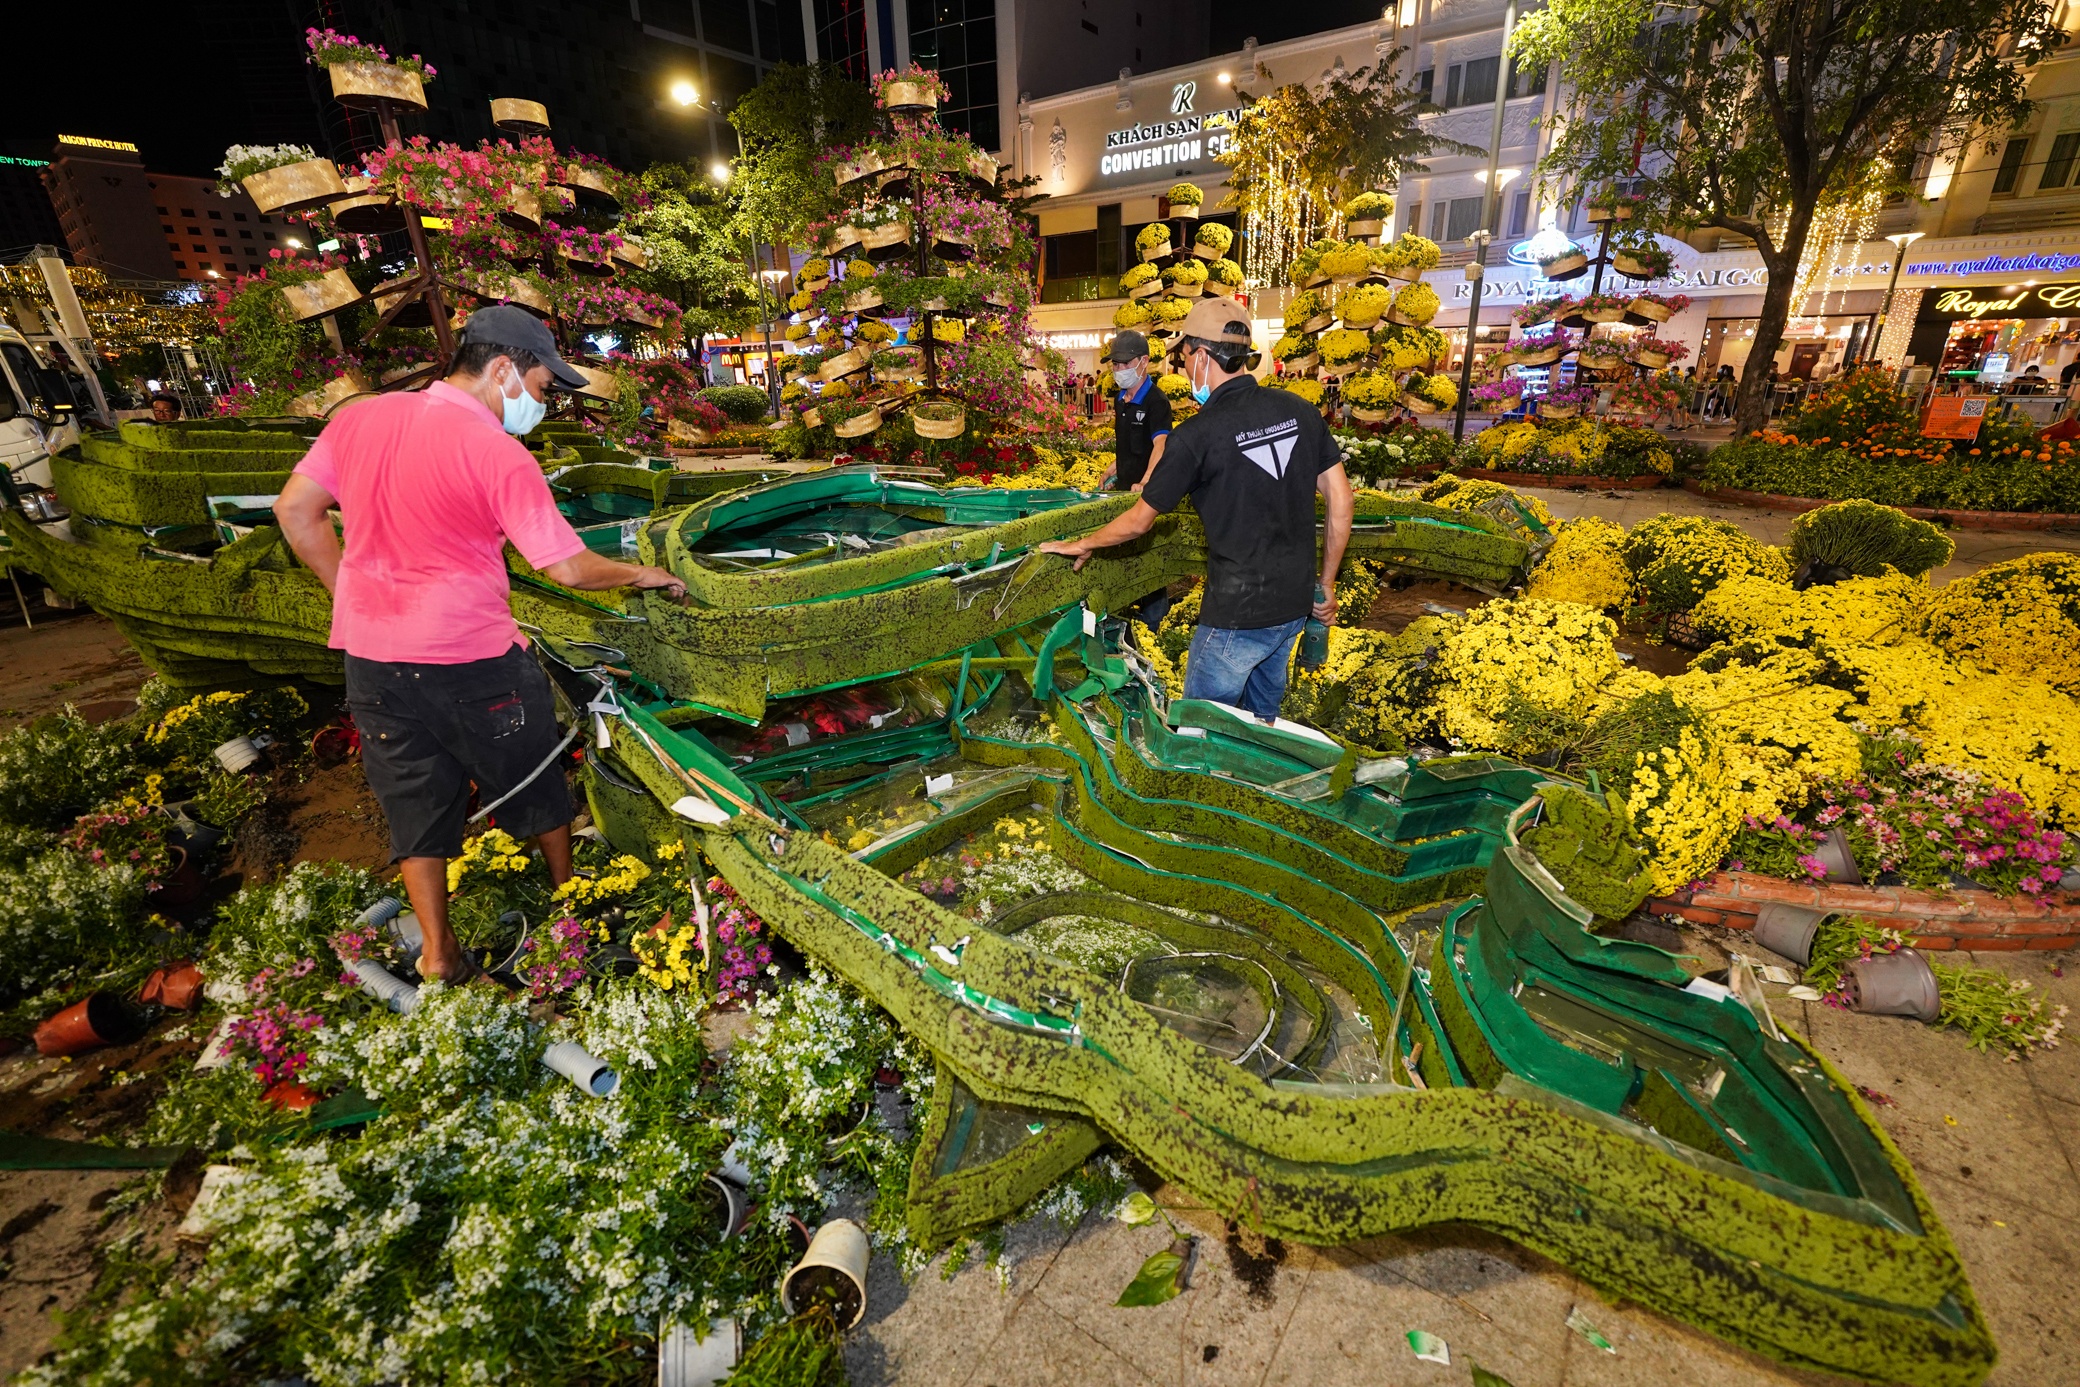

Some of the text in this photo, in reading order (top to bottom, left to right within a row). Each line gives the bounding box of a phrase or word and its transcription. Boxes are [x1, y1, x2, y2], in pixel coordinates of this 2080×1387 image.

[58, 134, 138, 152] SAIGON PRINCE HOTEL
[1106, 123, 1163, 148] KHÁCH
[1166, 117, 1200, 138] SẠN
[1101, 140, 1202, 175] CONVENTION
[1906, 253, 2080, 277] www.royalhotelsaigo
[1669, 267, 1770, 288] SAIGO
[1935, 290, 2029, 318] Royal
[1049, 333, 1101, 349] CENTRAL
